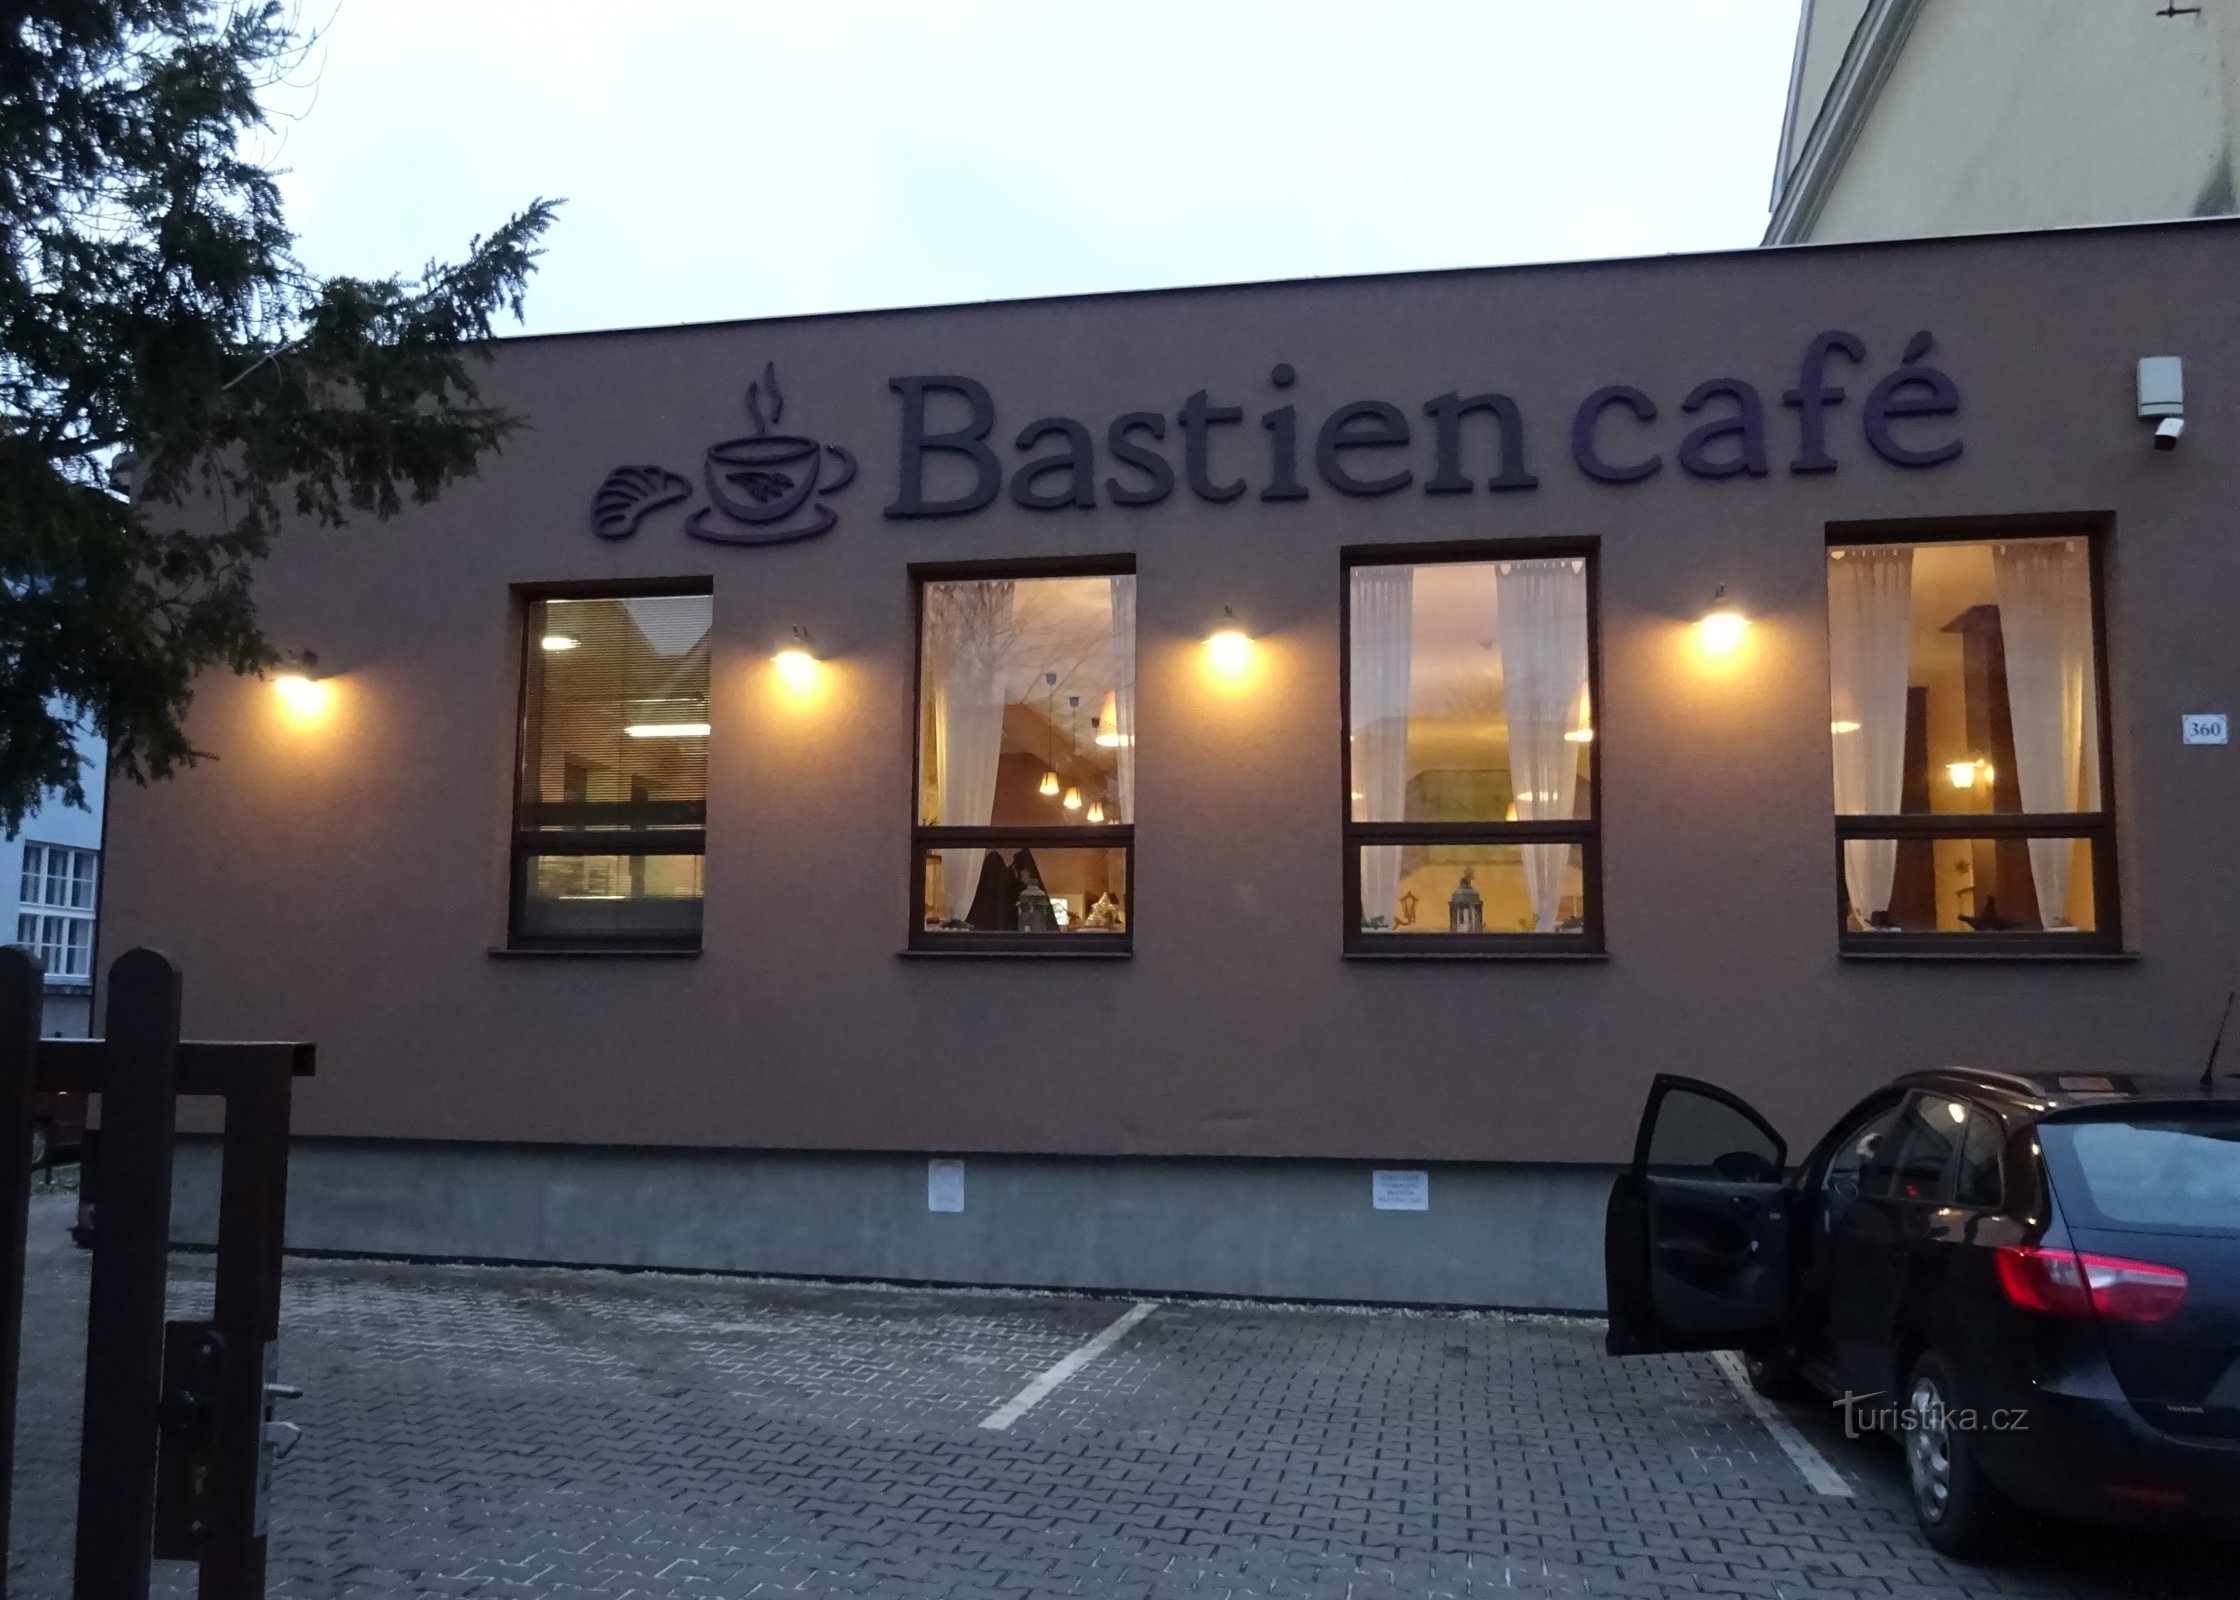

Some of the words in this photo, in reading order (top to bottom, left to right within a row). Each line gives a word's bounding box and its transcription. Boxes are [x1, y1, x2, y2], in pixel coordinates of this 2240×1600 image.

[883, 363, 1539, 520] Bastien
[1571, 329, 1964, 483] café
[2190, 722, 2221, 737] 360
